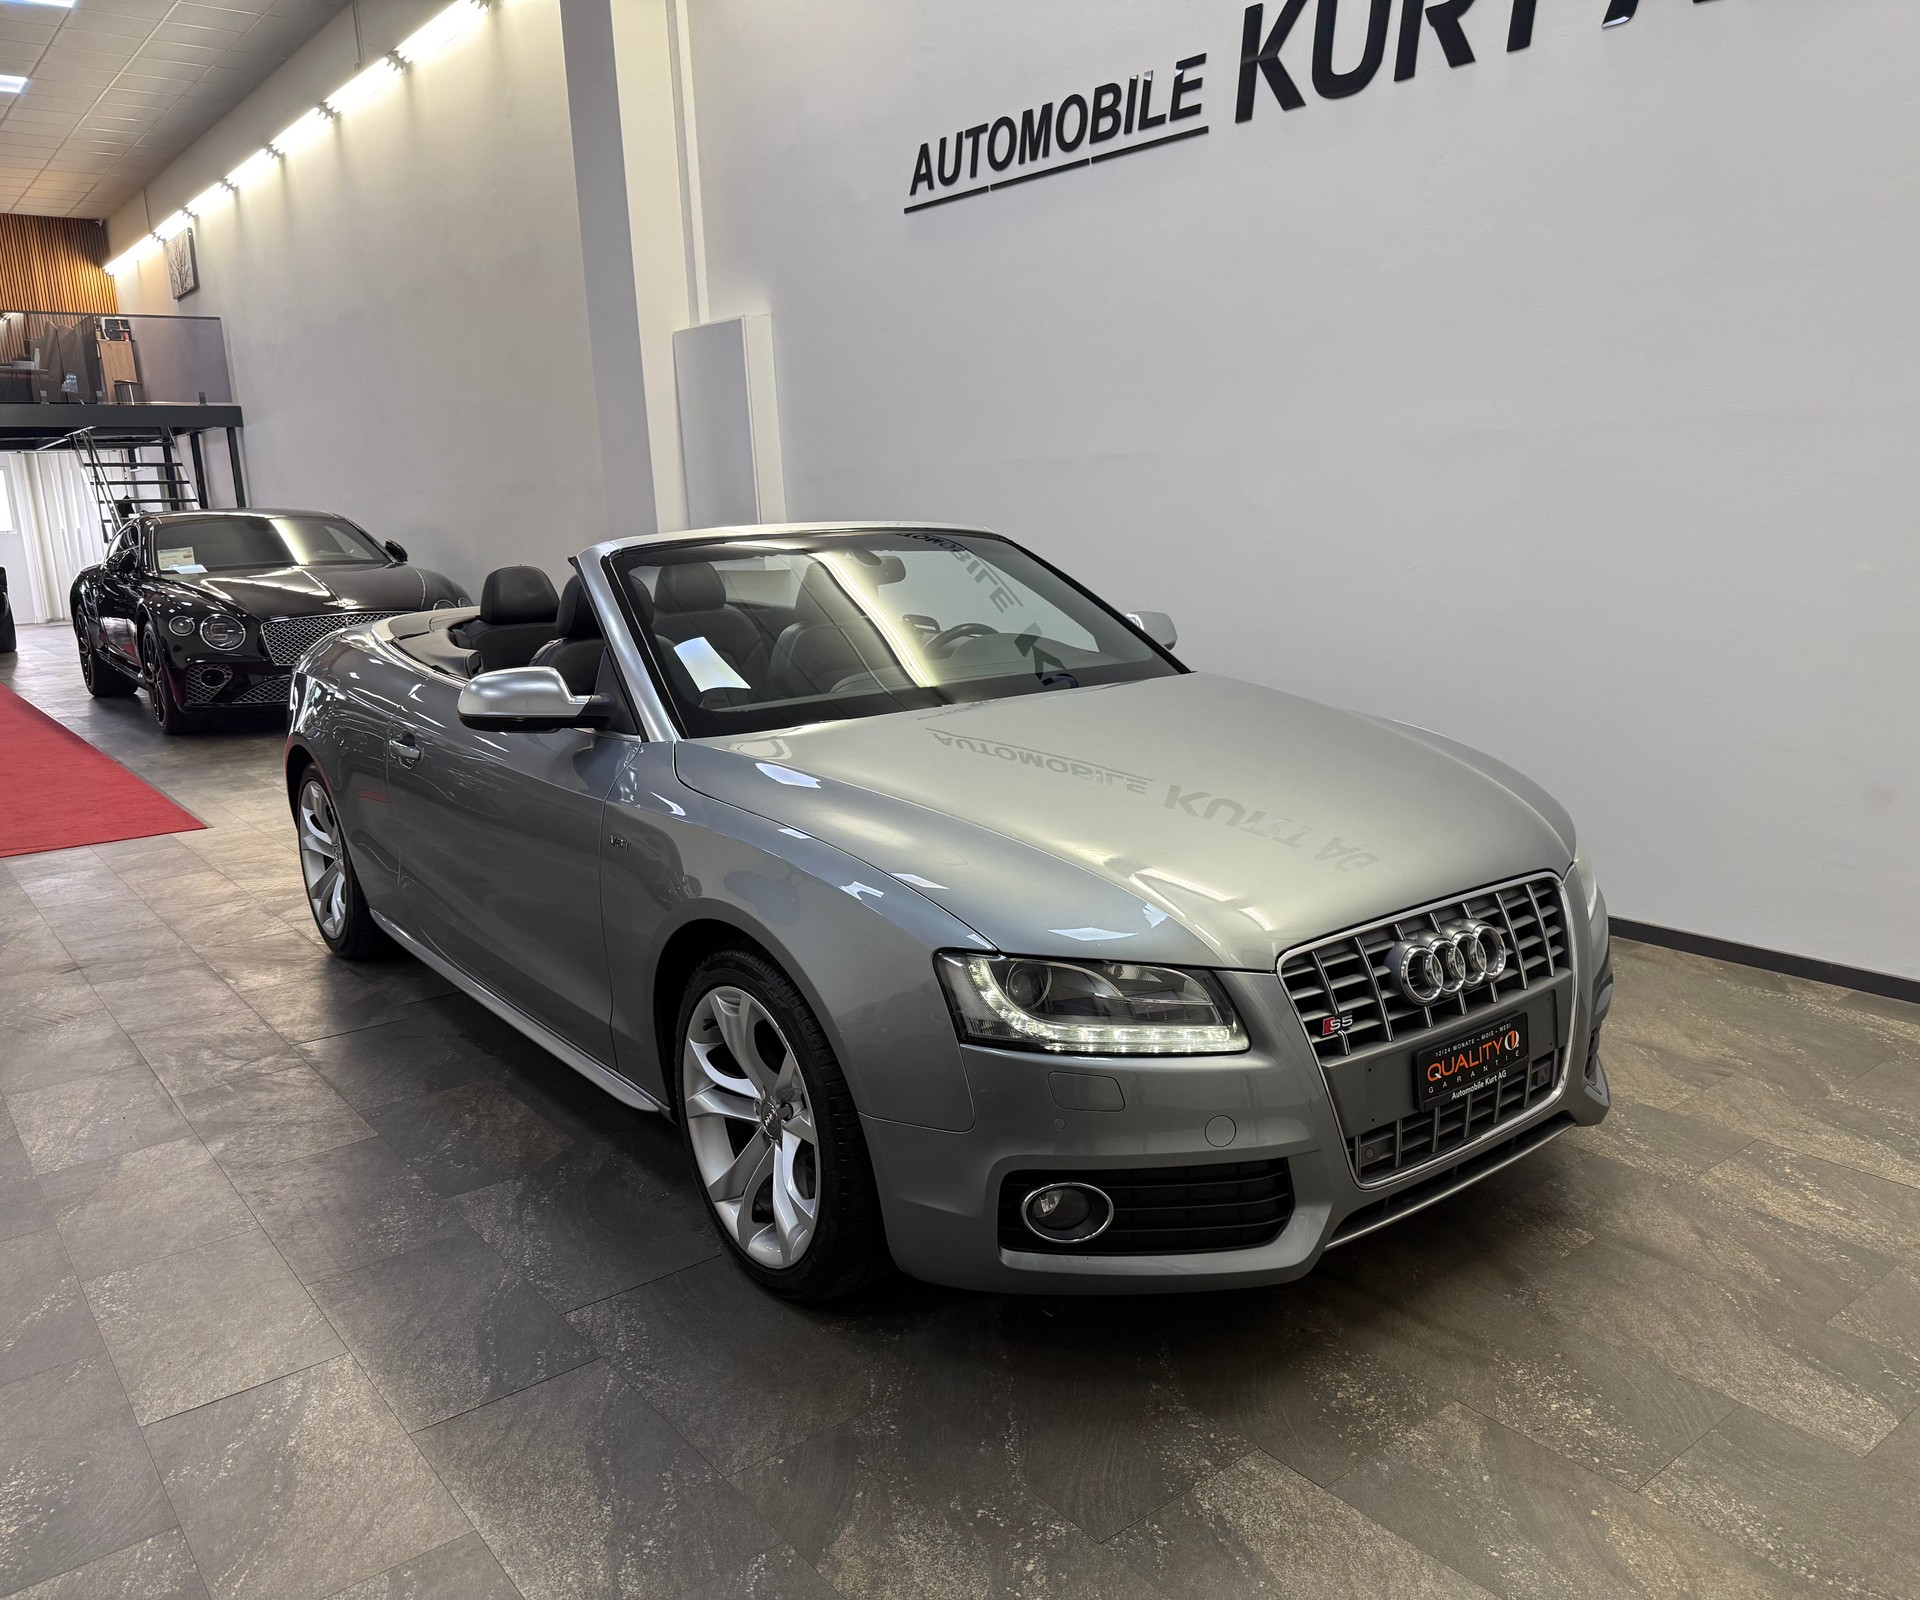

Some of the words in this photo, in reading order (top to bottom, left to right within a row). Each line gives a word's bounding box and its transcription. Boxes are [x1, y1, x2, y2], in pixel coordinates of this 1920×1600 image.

[909, 53, 1207, 197] AUTOMOBILE
[1329, 1014, 1353, 1031] S5
[1453, 1039, 1475, 1051] MONATE
[1481, 1031, 1494, 1040] MOIS
[1427, 1036, 1503, 1082] QUALITY
[1428, 1050, 1519, 1094] GARANTIE
[1451, 1081, 1484, 1100] Automobile
[1484, 1074, 1498, 1086] Kurt
[1497, 1069, 1507, 1079] AG
